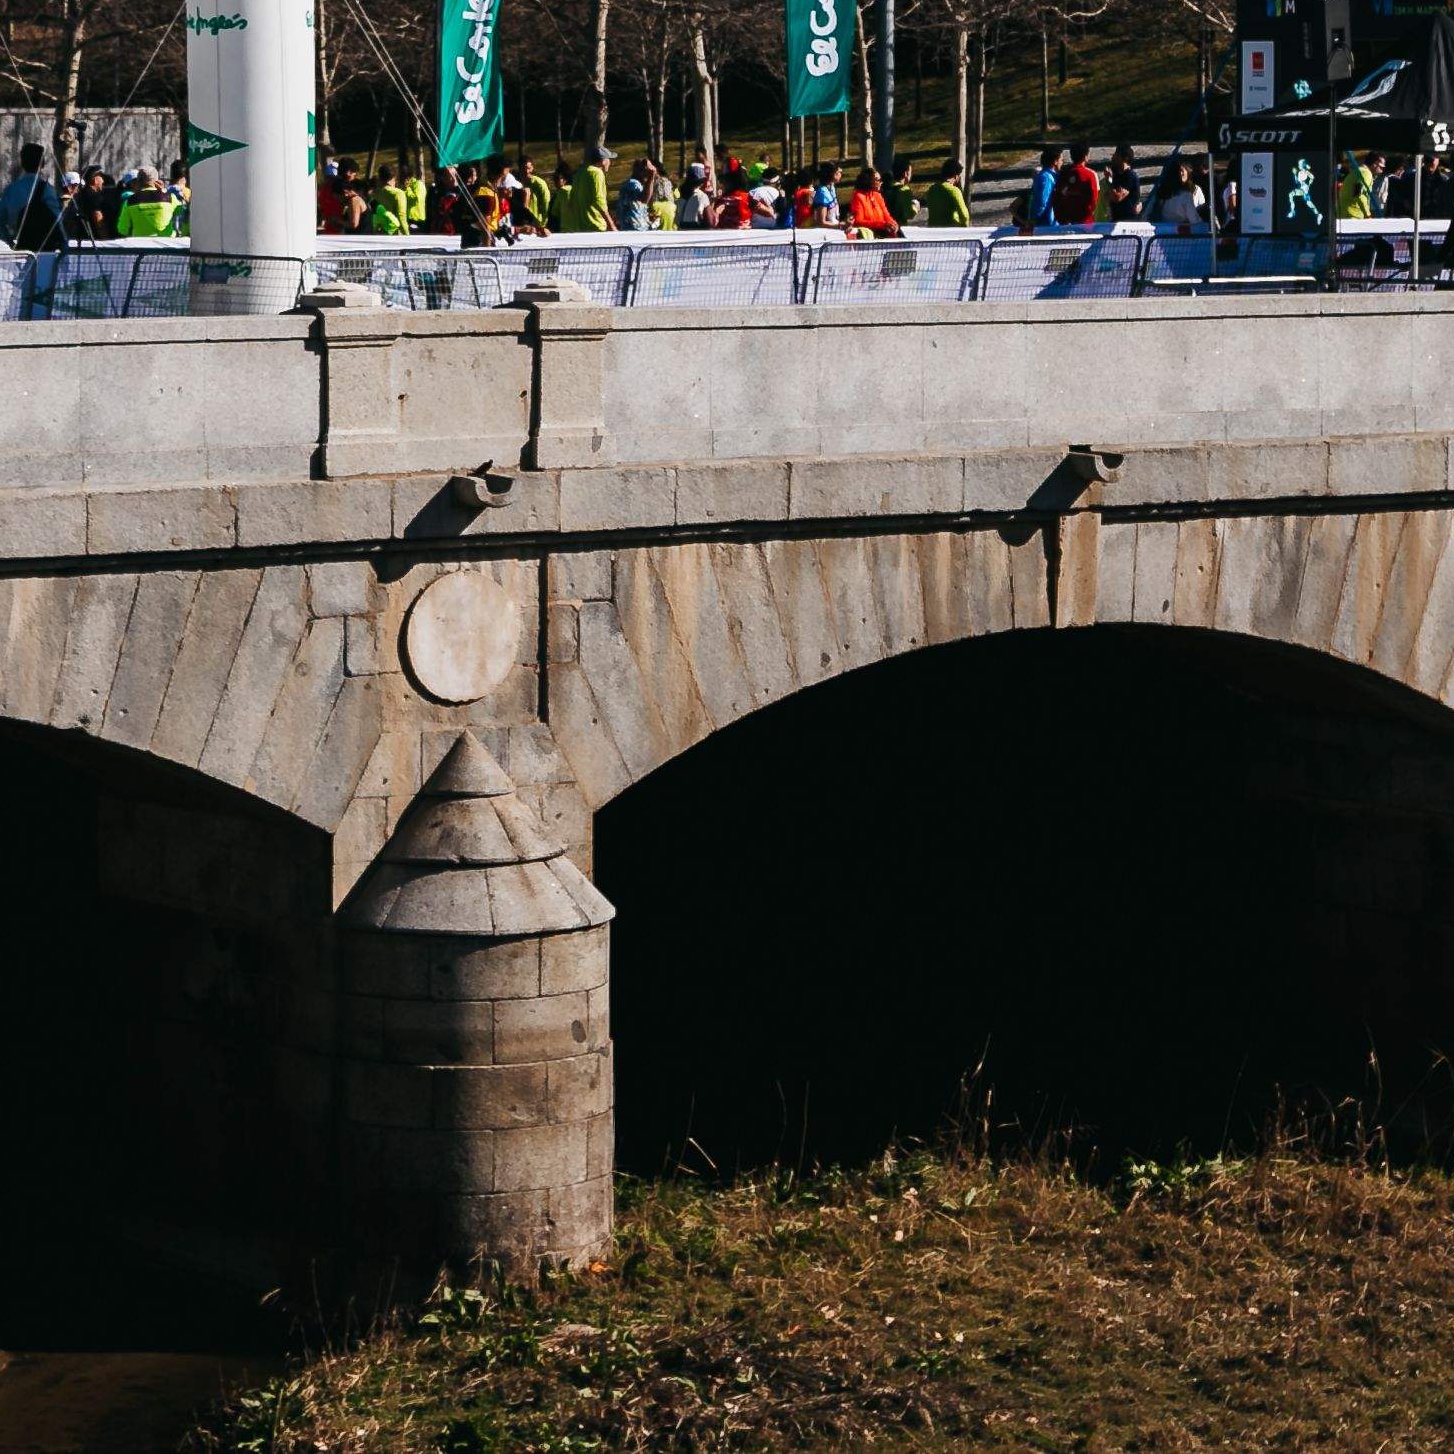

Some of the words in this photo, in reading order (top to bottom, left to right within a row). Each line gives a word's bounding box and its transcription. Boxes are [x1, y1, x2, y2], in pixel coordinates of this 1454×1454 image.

[195, 6, 248, 36] Inglés
[806, 37, 839, 77] El
[454, 83, 485, 124] El
[1235, 130, 1302, 144] SCOTT
